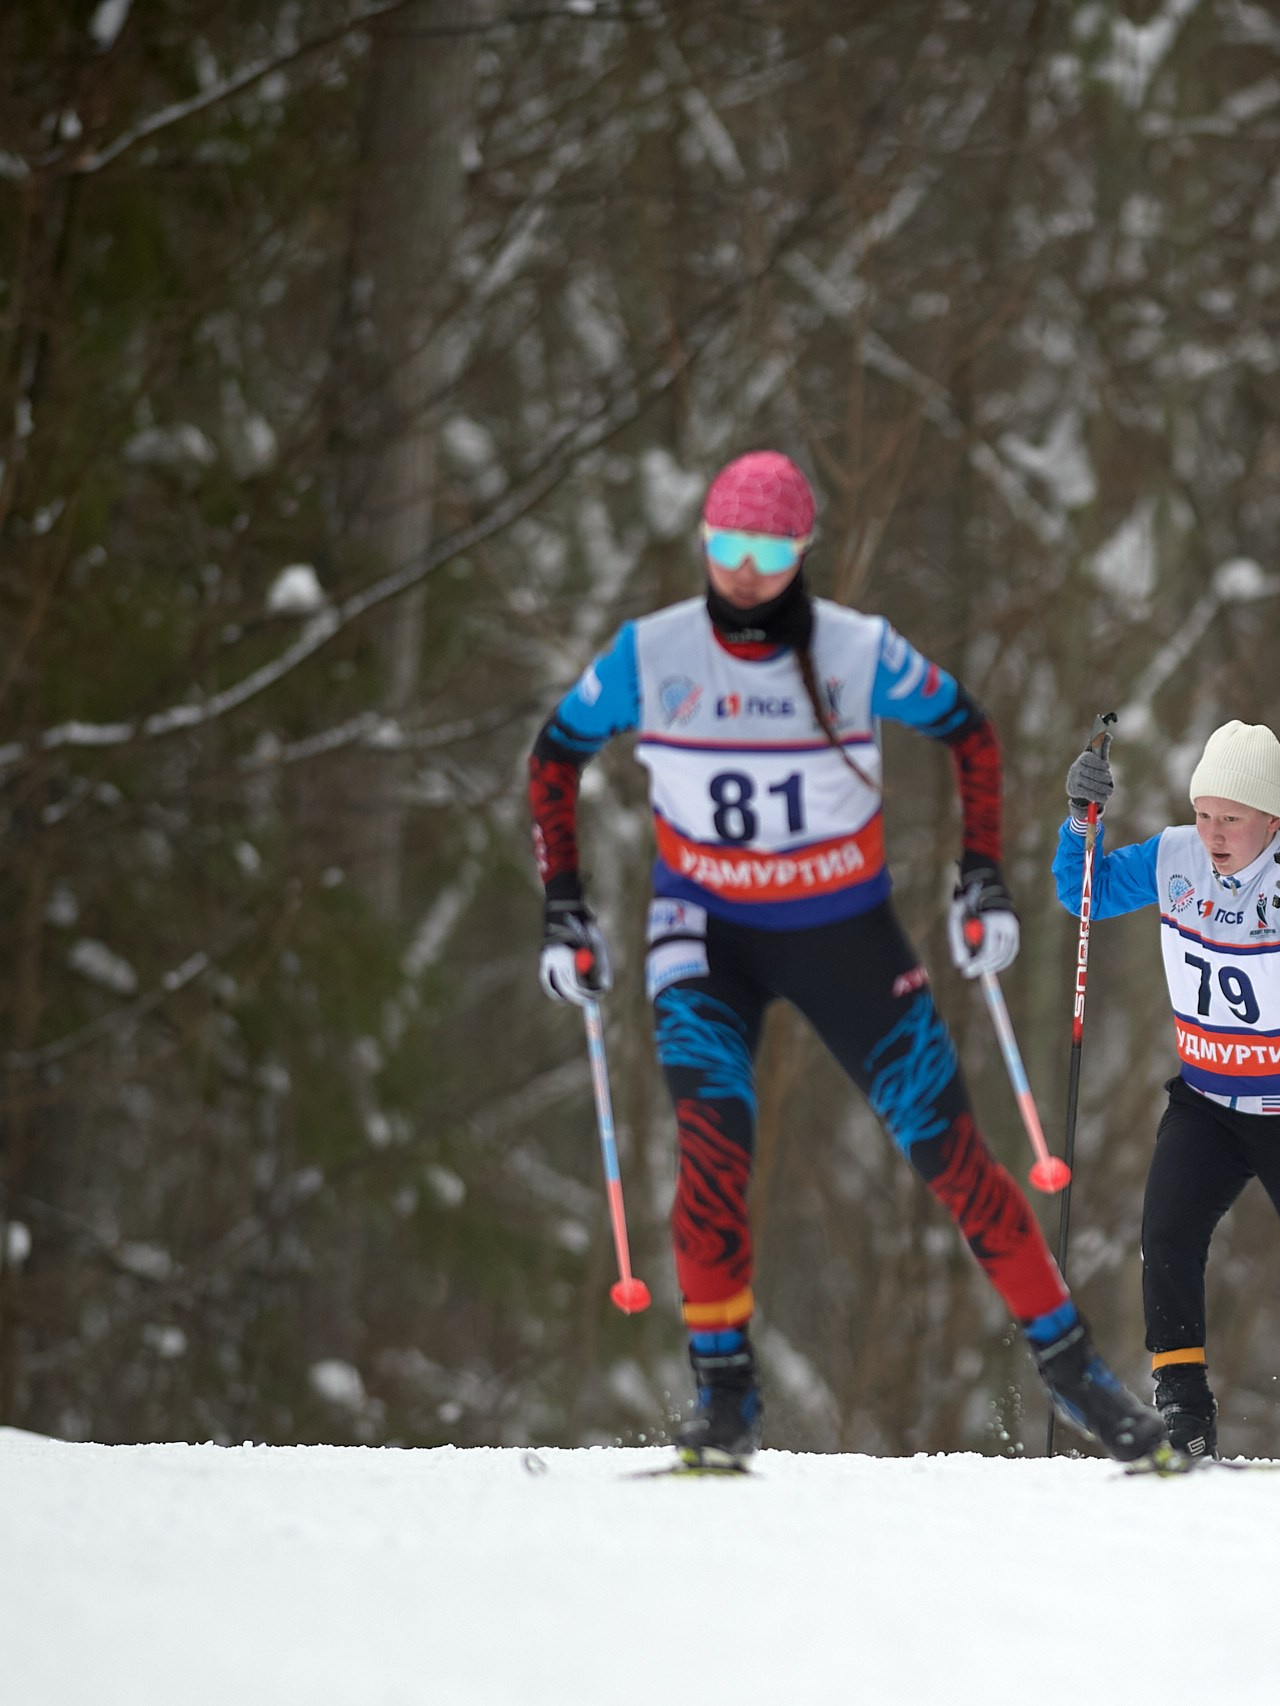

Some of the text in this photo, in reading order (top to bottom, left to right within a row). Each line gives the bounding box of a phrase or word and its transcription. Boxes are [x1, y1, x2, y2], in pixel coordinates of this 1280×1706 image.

[709, 770, 809, 845] 81
[679, 841, 865, 889] УДМУРТИЯ
[1214, 908, 1244, 925] ПСБ
[1185, 951, 1261, 1025] 79
